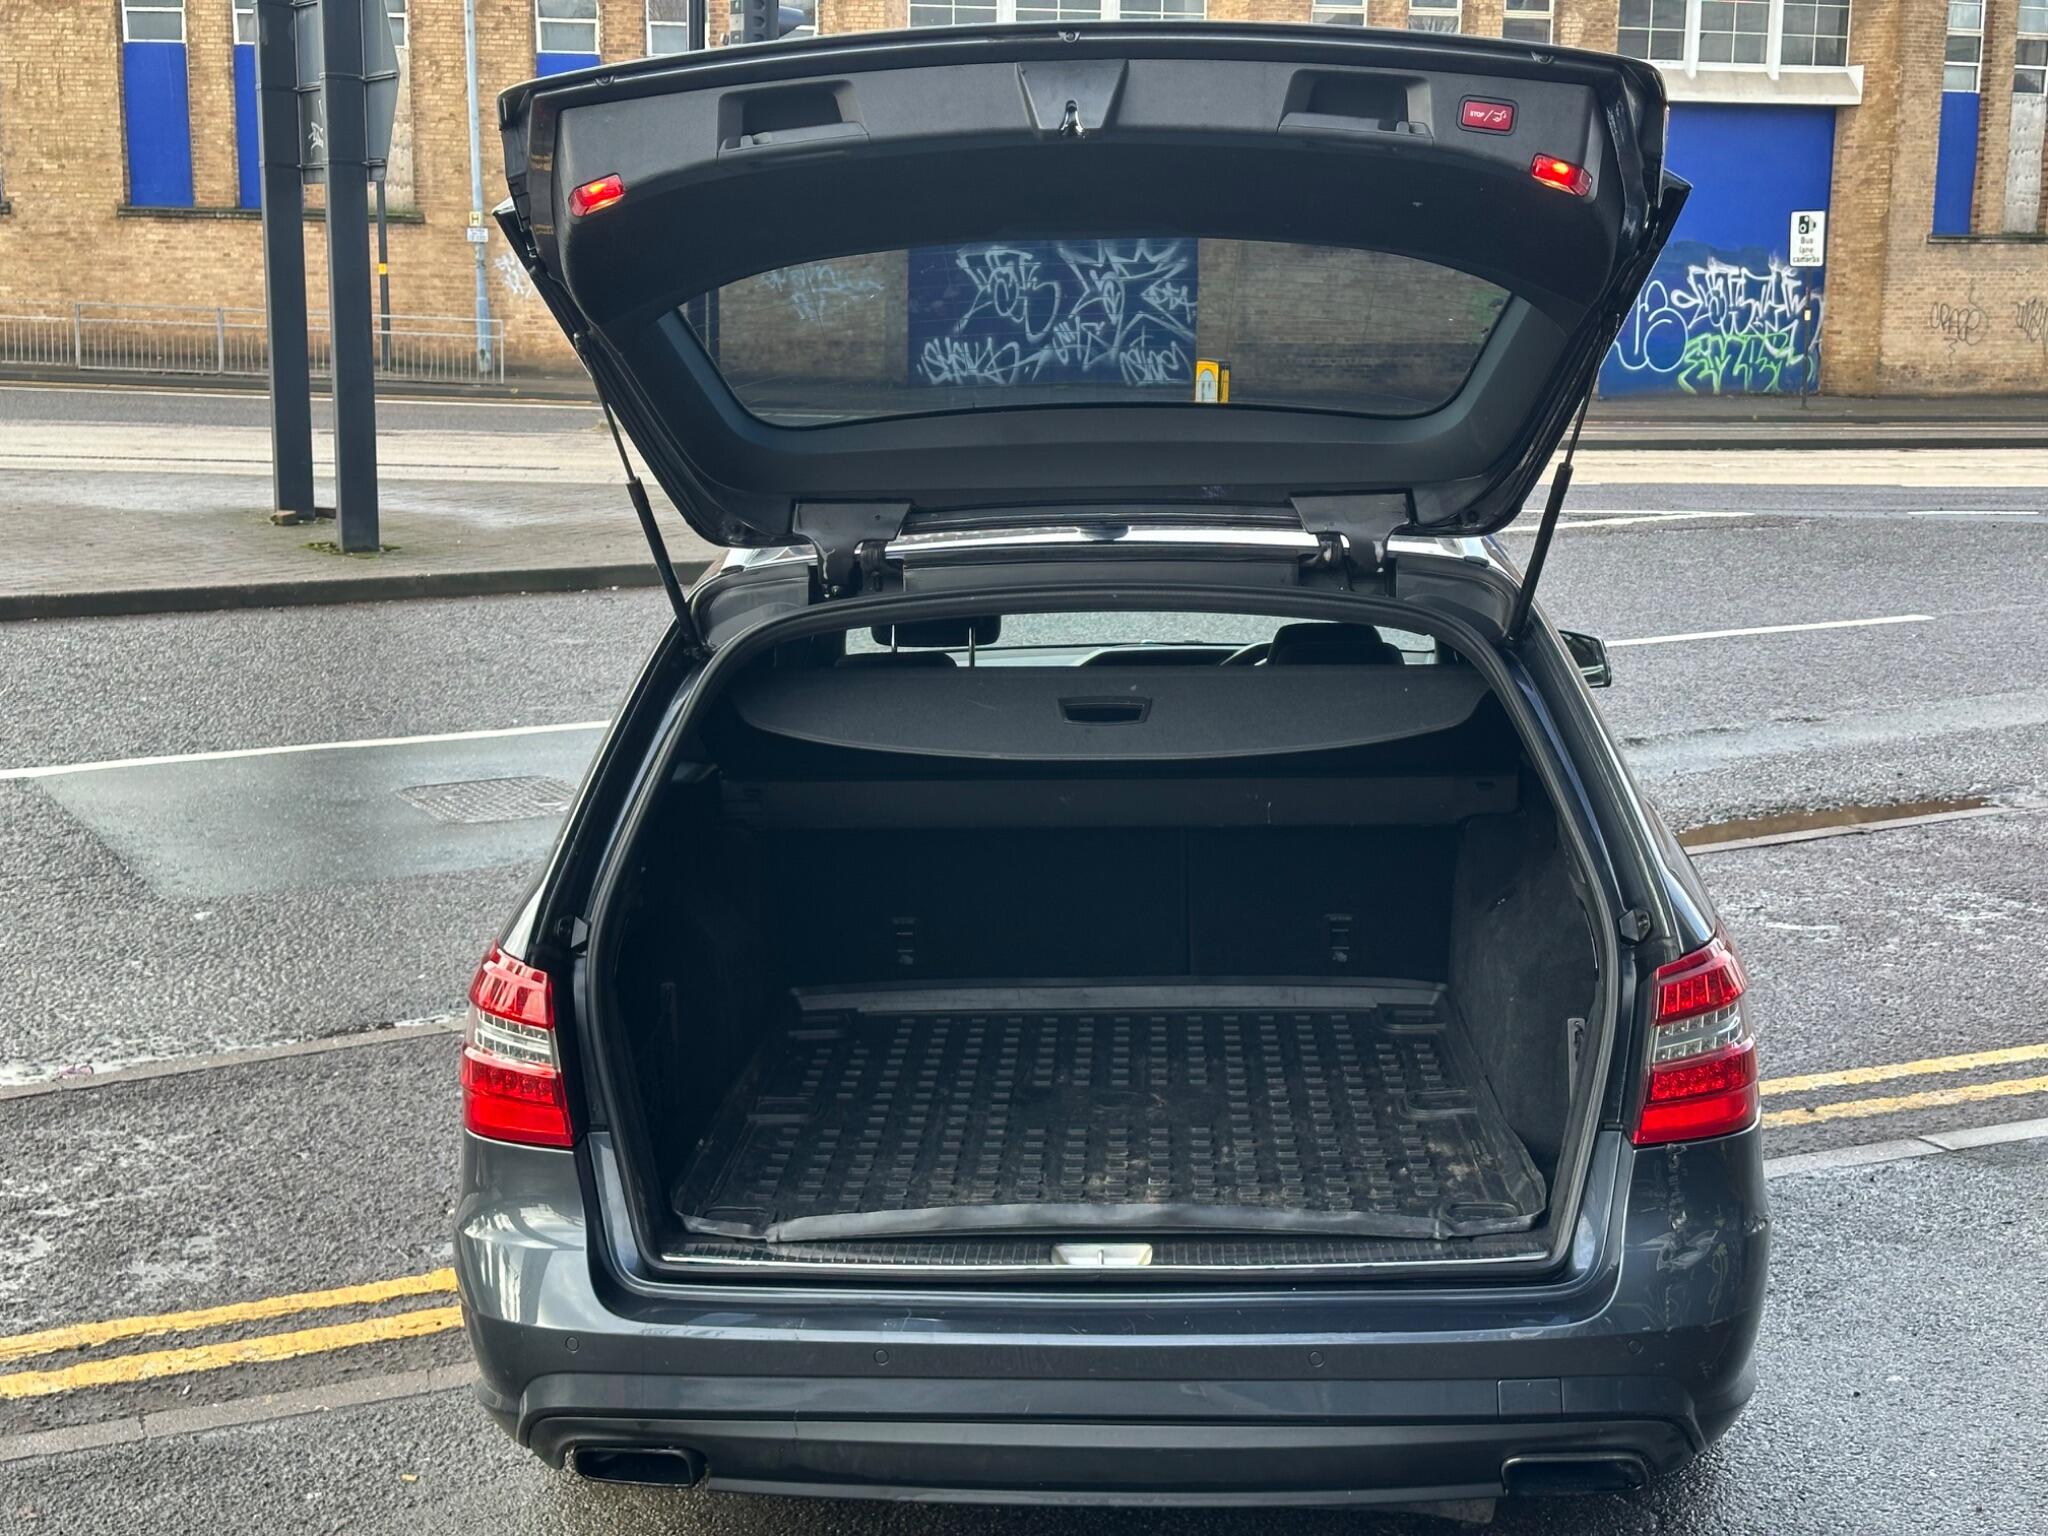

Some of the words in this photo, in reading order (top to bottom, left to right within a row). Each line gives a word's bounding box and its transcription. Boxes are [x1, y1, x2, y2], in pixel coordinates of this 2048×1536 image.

[1470, 110, 1485, 118] STOP
[1800, 236, 1813, 244] Bus
[1799, 245, 1813, 254] lane
